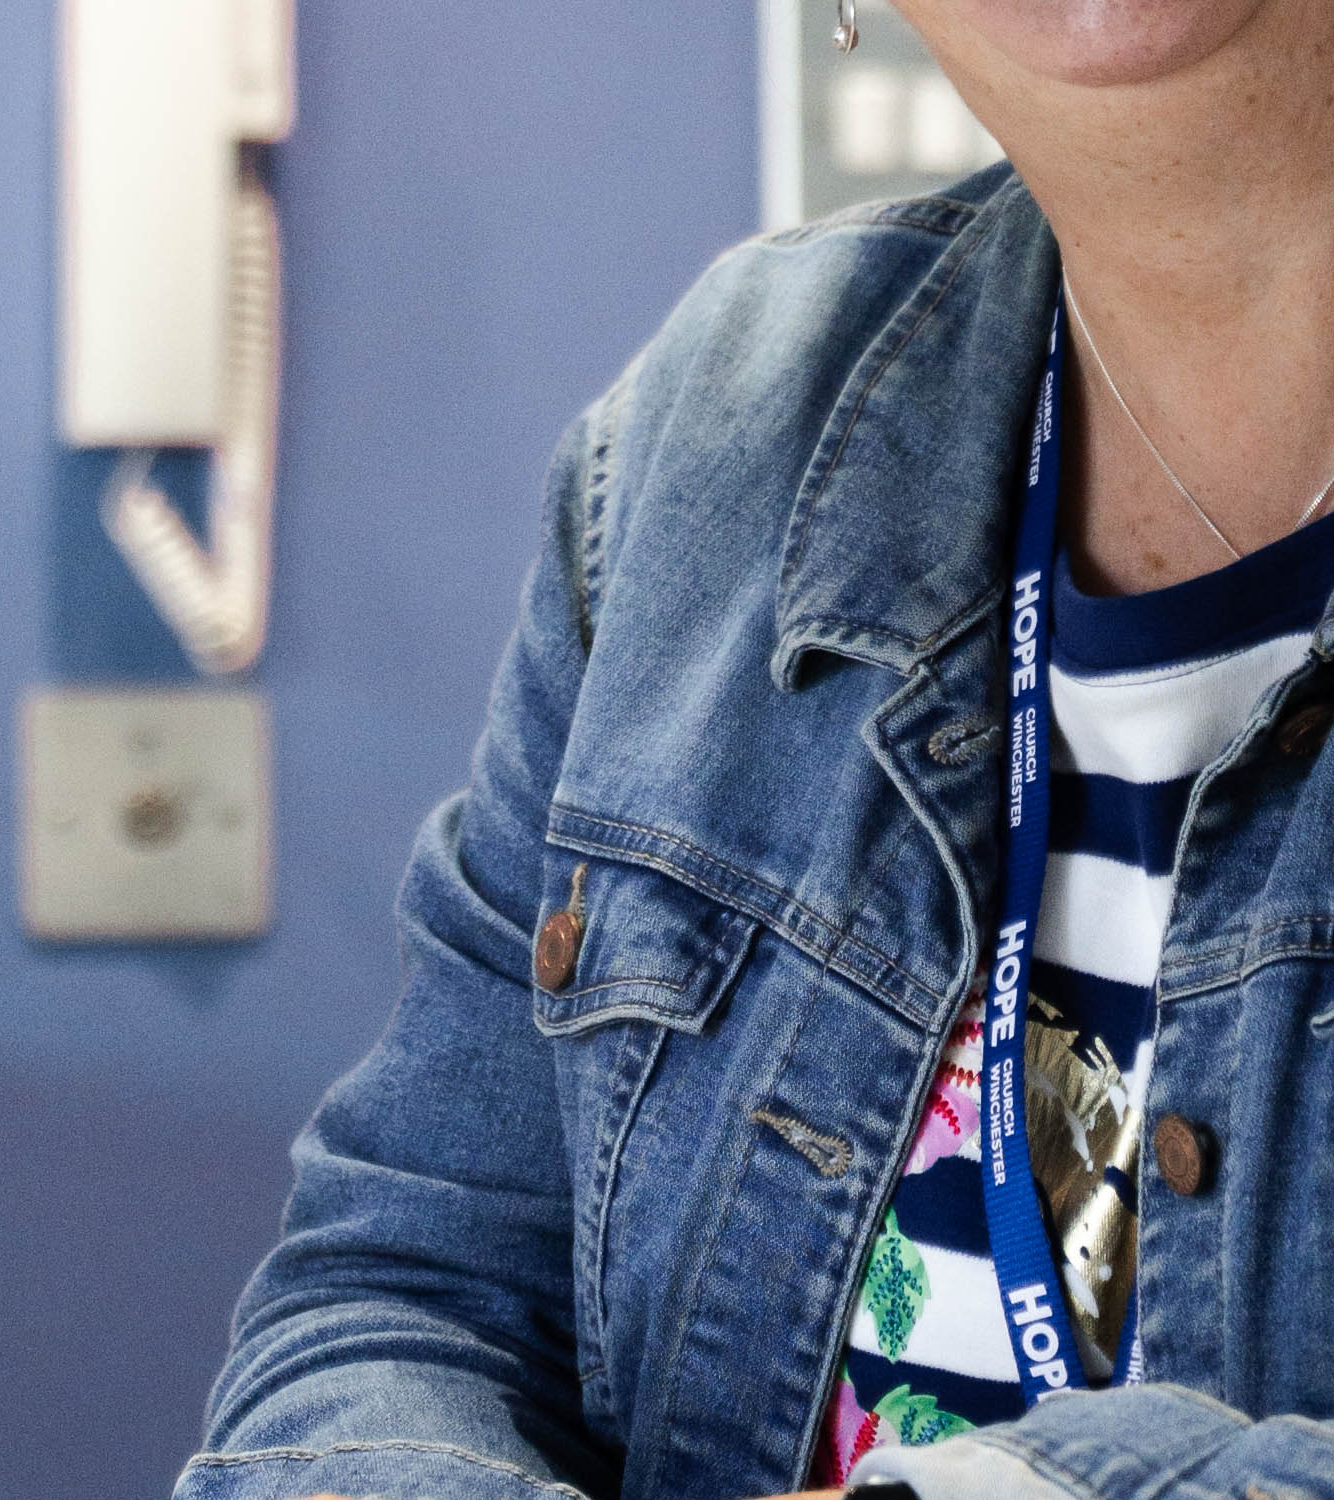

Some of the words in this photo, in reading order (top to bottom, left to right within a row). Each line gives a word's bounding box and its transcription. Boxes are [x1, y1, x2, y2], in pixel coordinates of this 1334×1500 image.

[1043, 371, 1053, 443] CHURCH
[1013, 571, 1041, 697] HOPE
[1010, 712, 1023, 829] WINCHESTER
[1025, 707, 1036, 783] CHURCH
[991, 920, 1027, 1047] HOPE
[990, 1062, 1005, 1186] WINCHESTER
[1002, 1057, 1015, 1137] CHURCH
